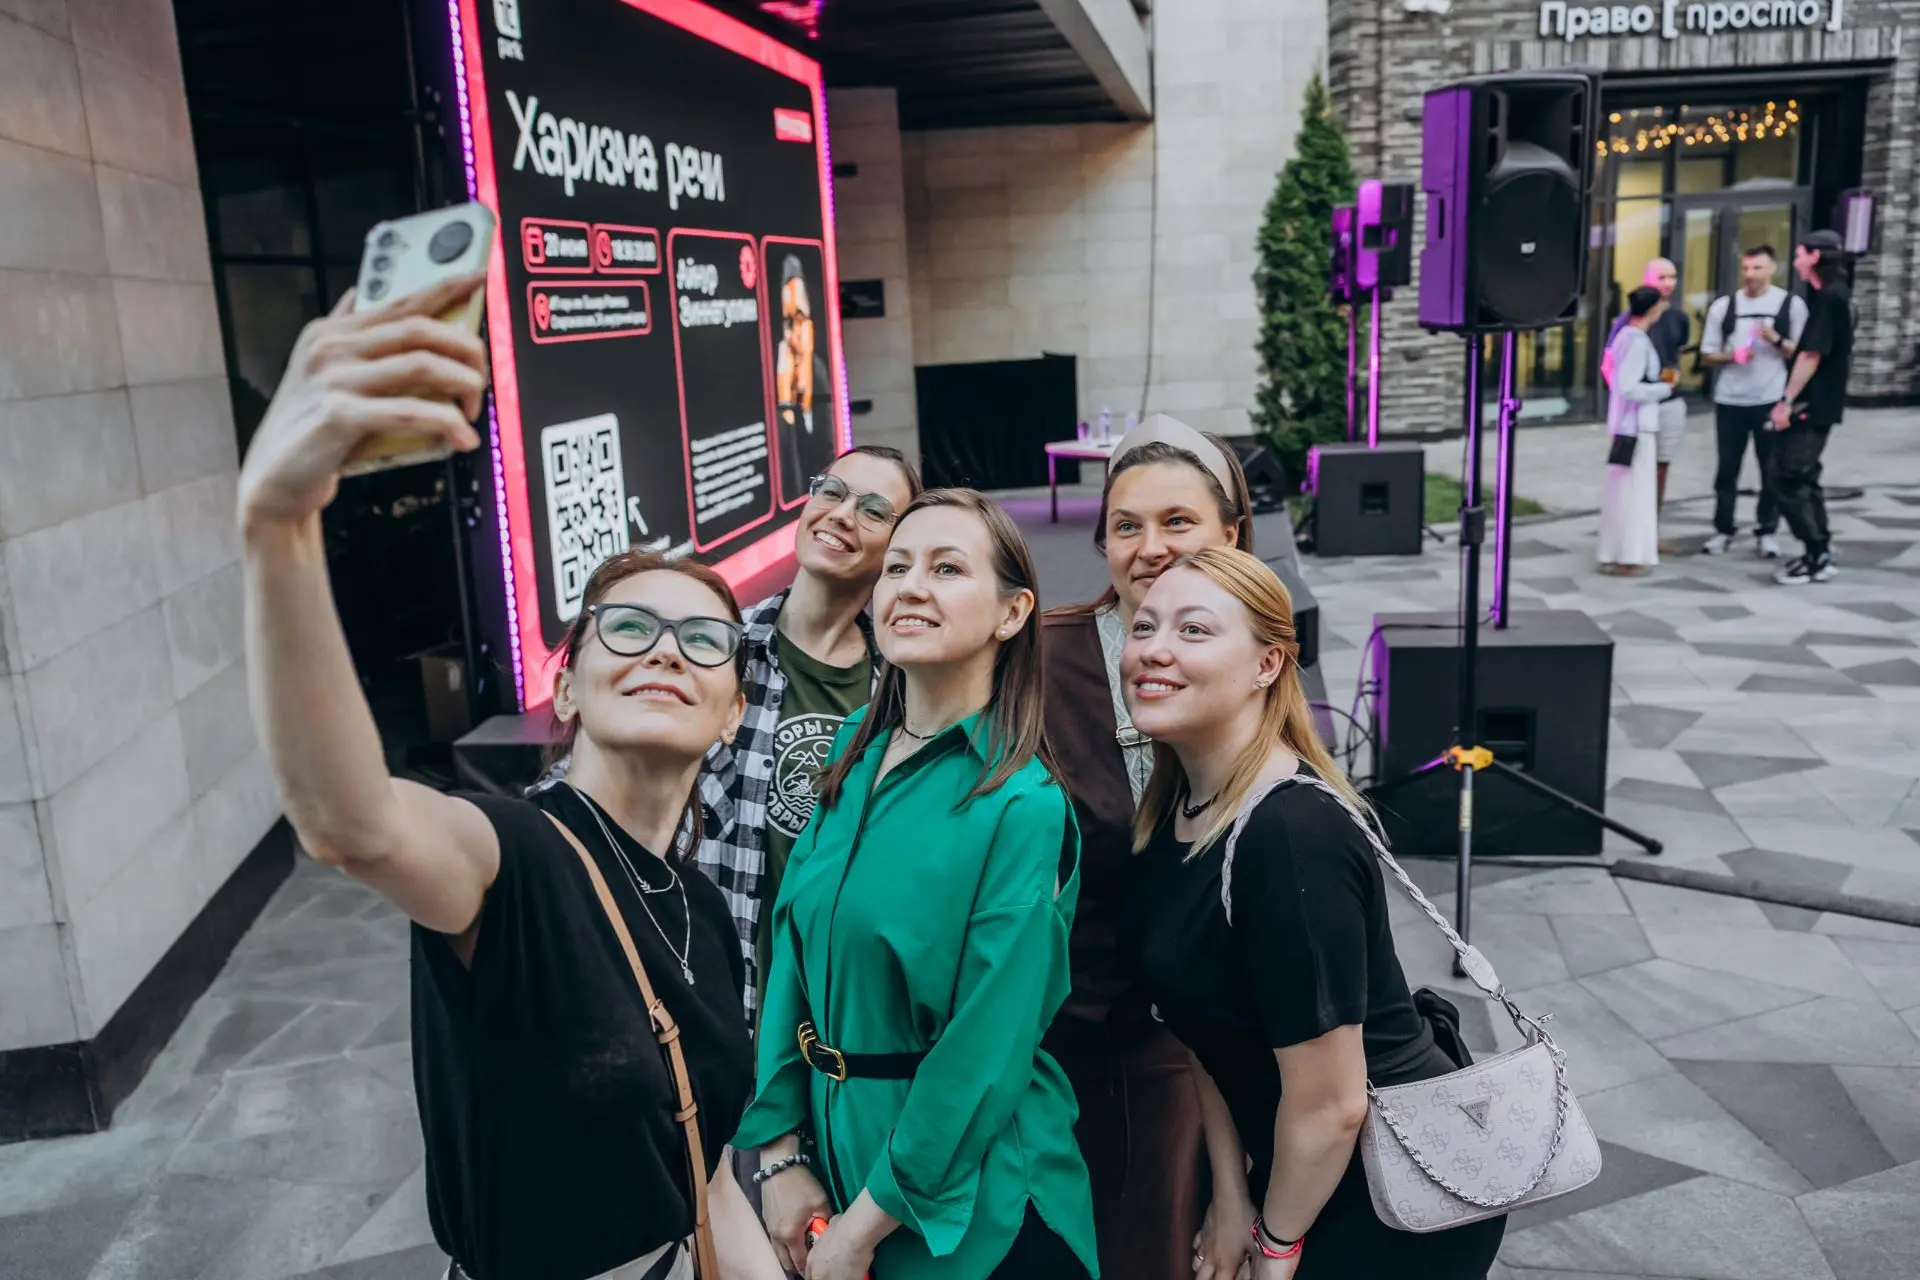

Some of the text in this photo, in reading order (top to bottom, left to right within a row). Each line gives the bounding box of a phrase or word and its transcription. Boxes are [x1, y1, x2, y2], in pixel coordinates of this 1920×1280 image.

[1540, 1, 1655, 42] Право
[505, 90, 726, 210] Харизма речи
[768, 781, 808, 832] ОБРЫ
